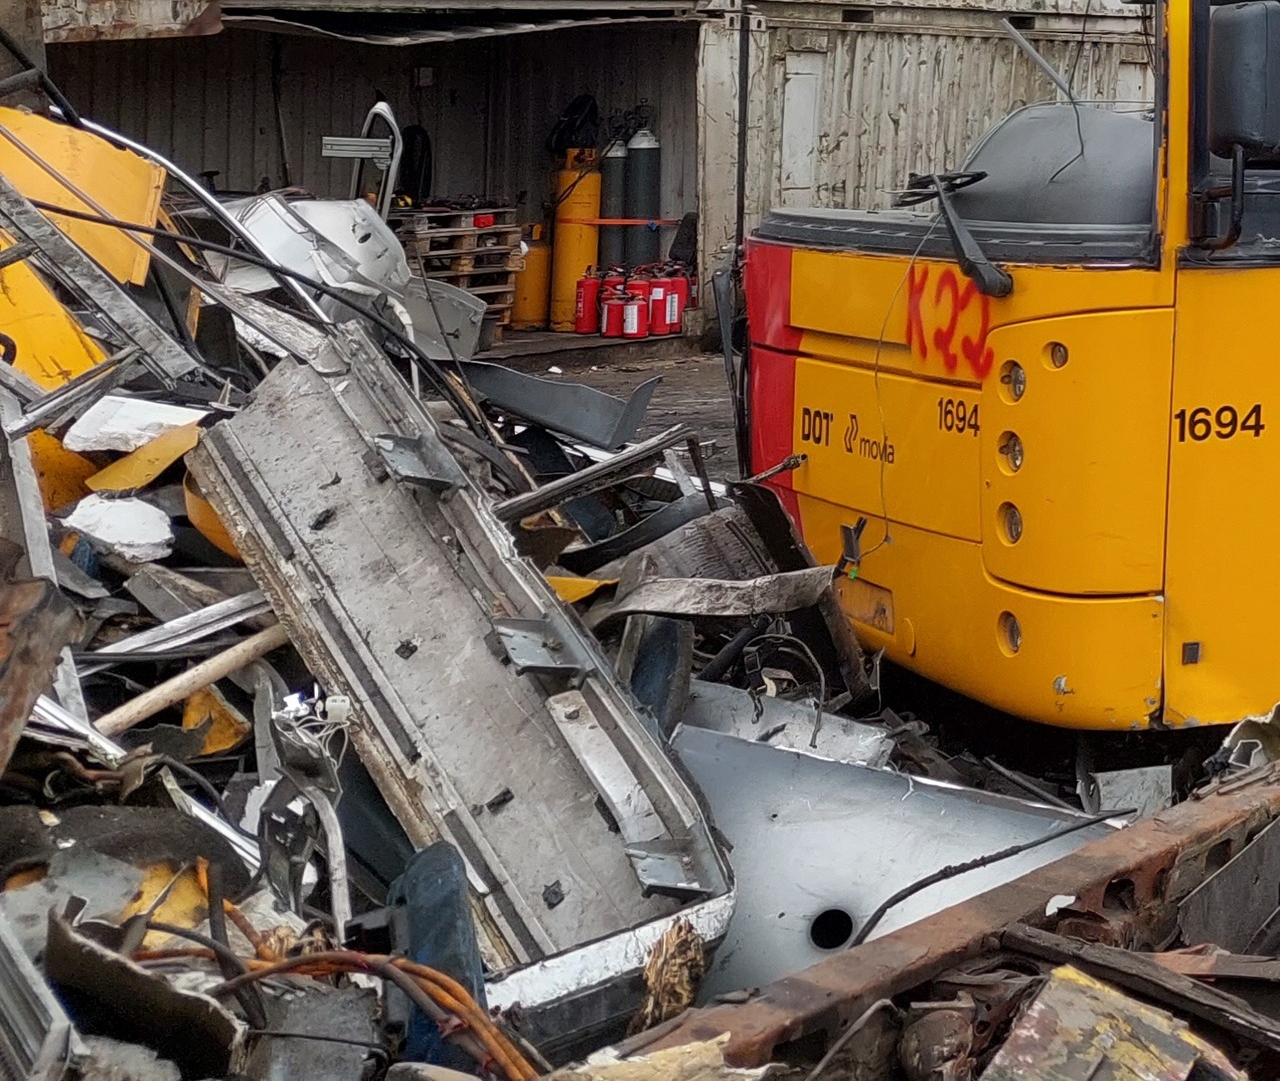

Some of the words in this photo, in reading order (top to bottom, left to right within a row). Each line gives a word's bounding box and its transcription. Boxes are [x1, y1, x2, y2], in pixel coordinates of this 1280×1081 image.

[801, 407, 834, 447] DOT
[937, 397, 981, 438] 1694
[1173, 403, 1265, 443] 1694
[859, 436, 895, 465] movia
